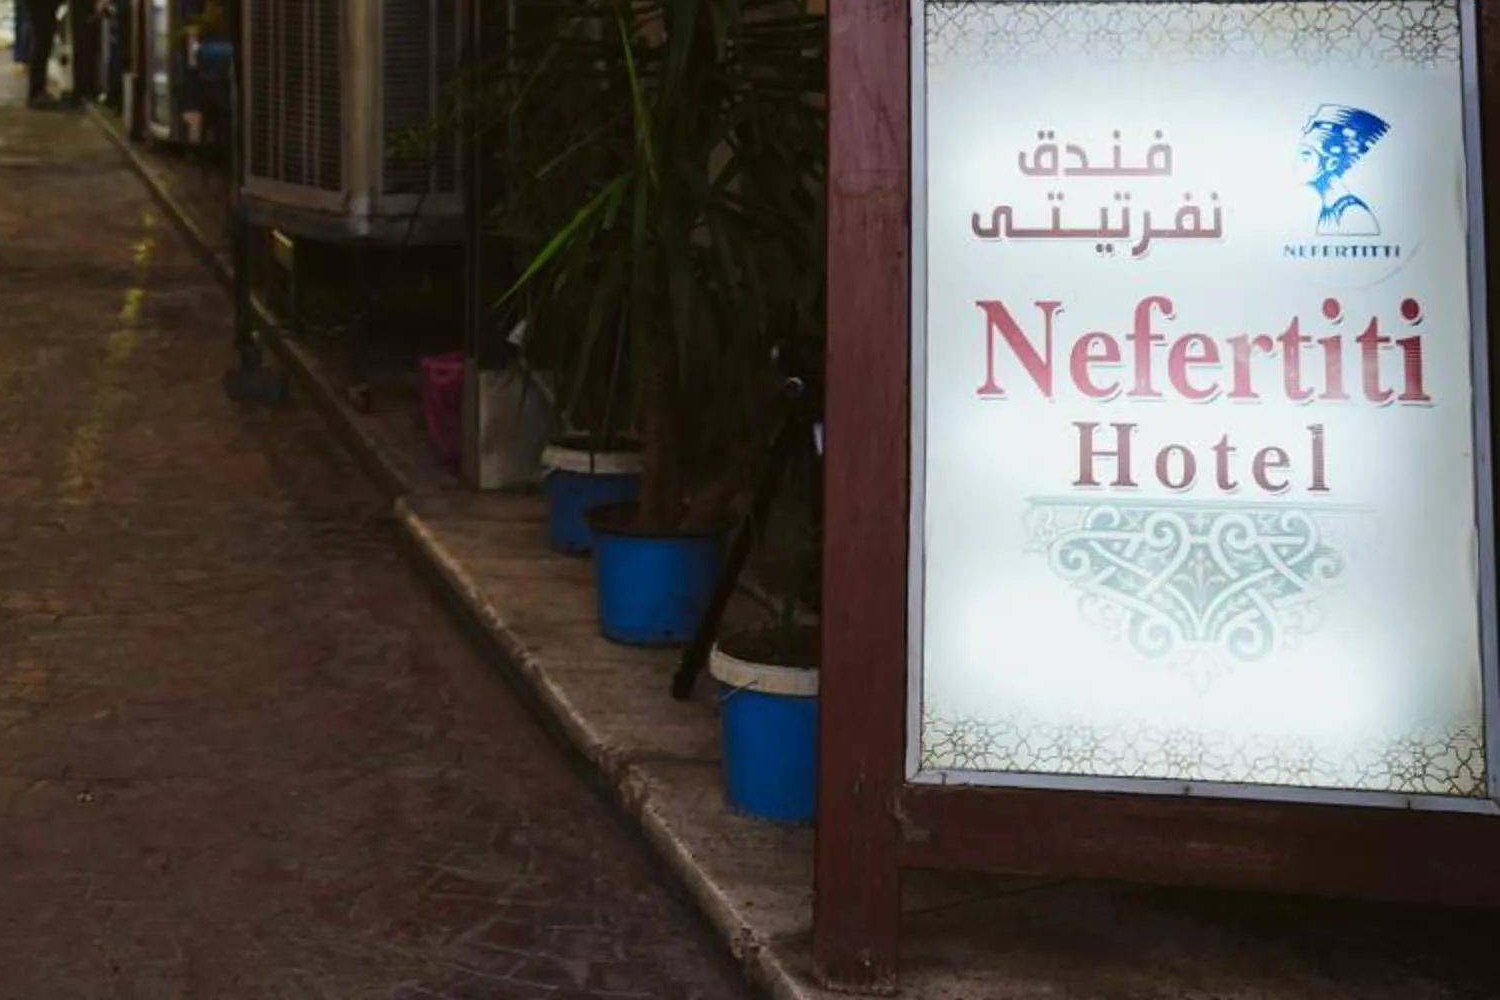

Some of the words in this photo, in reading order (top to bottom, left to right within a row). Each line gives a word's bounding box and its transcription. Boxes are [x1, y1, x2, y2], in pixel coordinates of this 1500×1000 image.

[1018, 129, 1173, 176] فندق
[975, 296, 1431, 405] Nefertiti
[1071, 422, 1331, 492] Hotel
